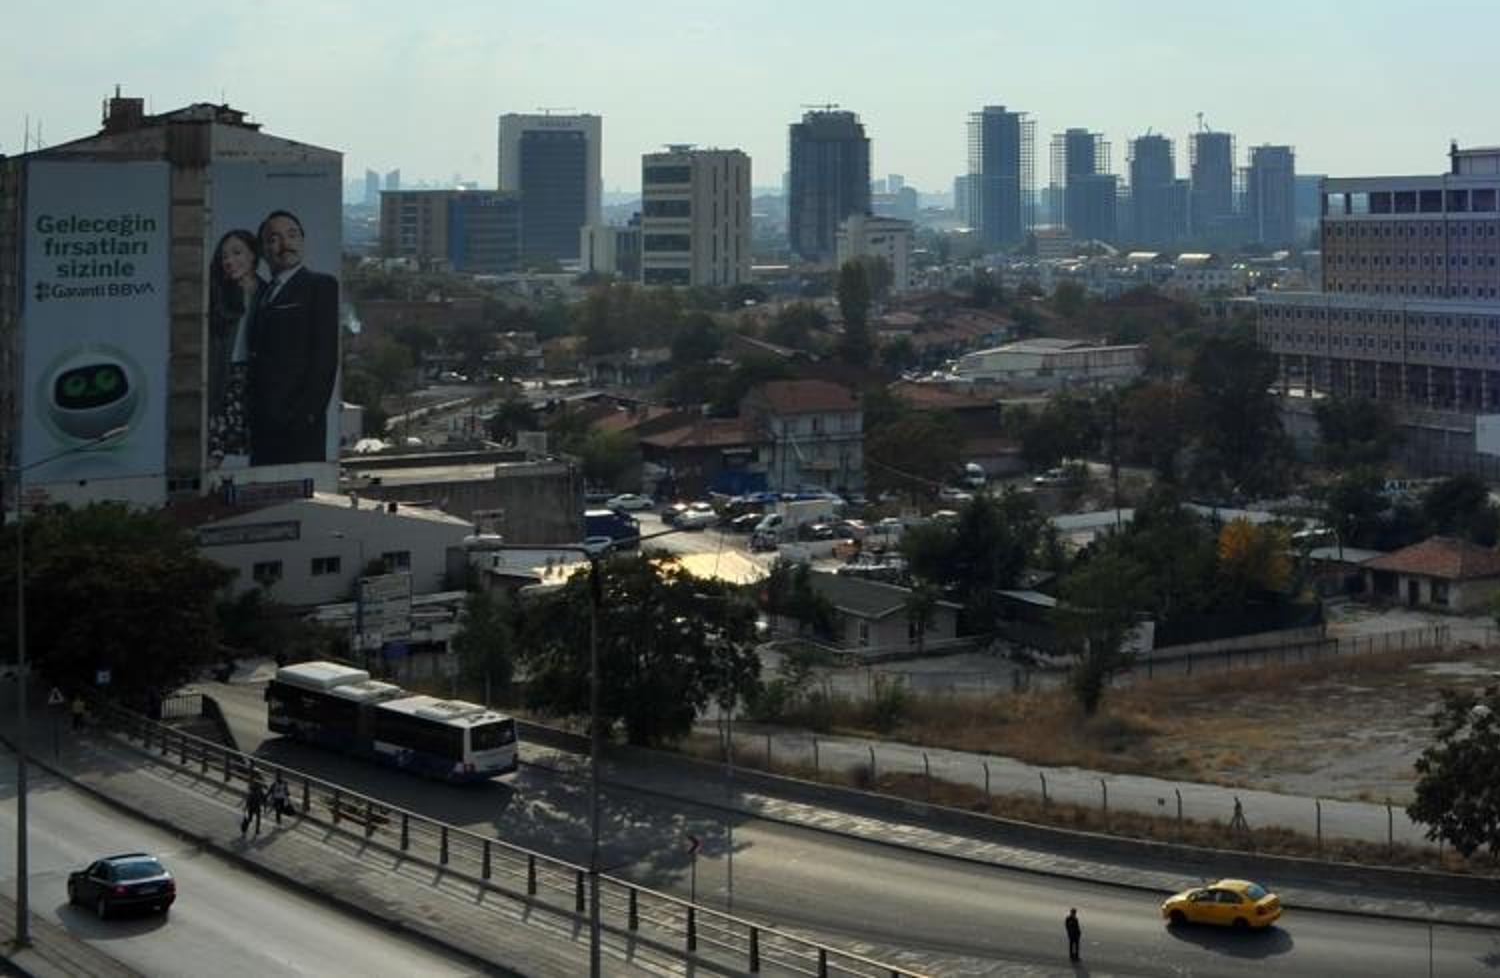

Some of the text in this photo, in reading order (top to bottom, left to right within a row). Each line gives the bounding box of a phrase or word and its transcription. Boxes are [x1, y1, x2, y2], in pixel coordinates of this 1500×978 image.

[36, 214, 157, 237] Geleceğin
[45, 237, 149, 256] fırsatları
[56, 258, 136, 278] sizinle
[51, 282, 155, 299] Garanti BBVA
